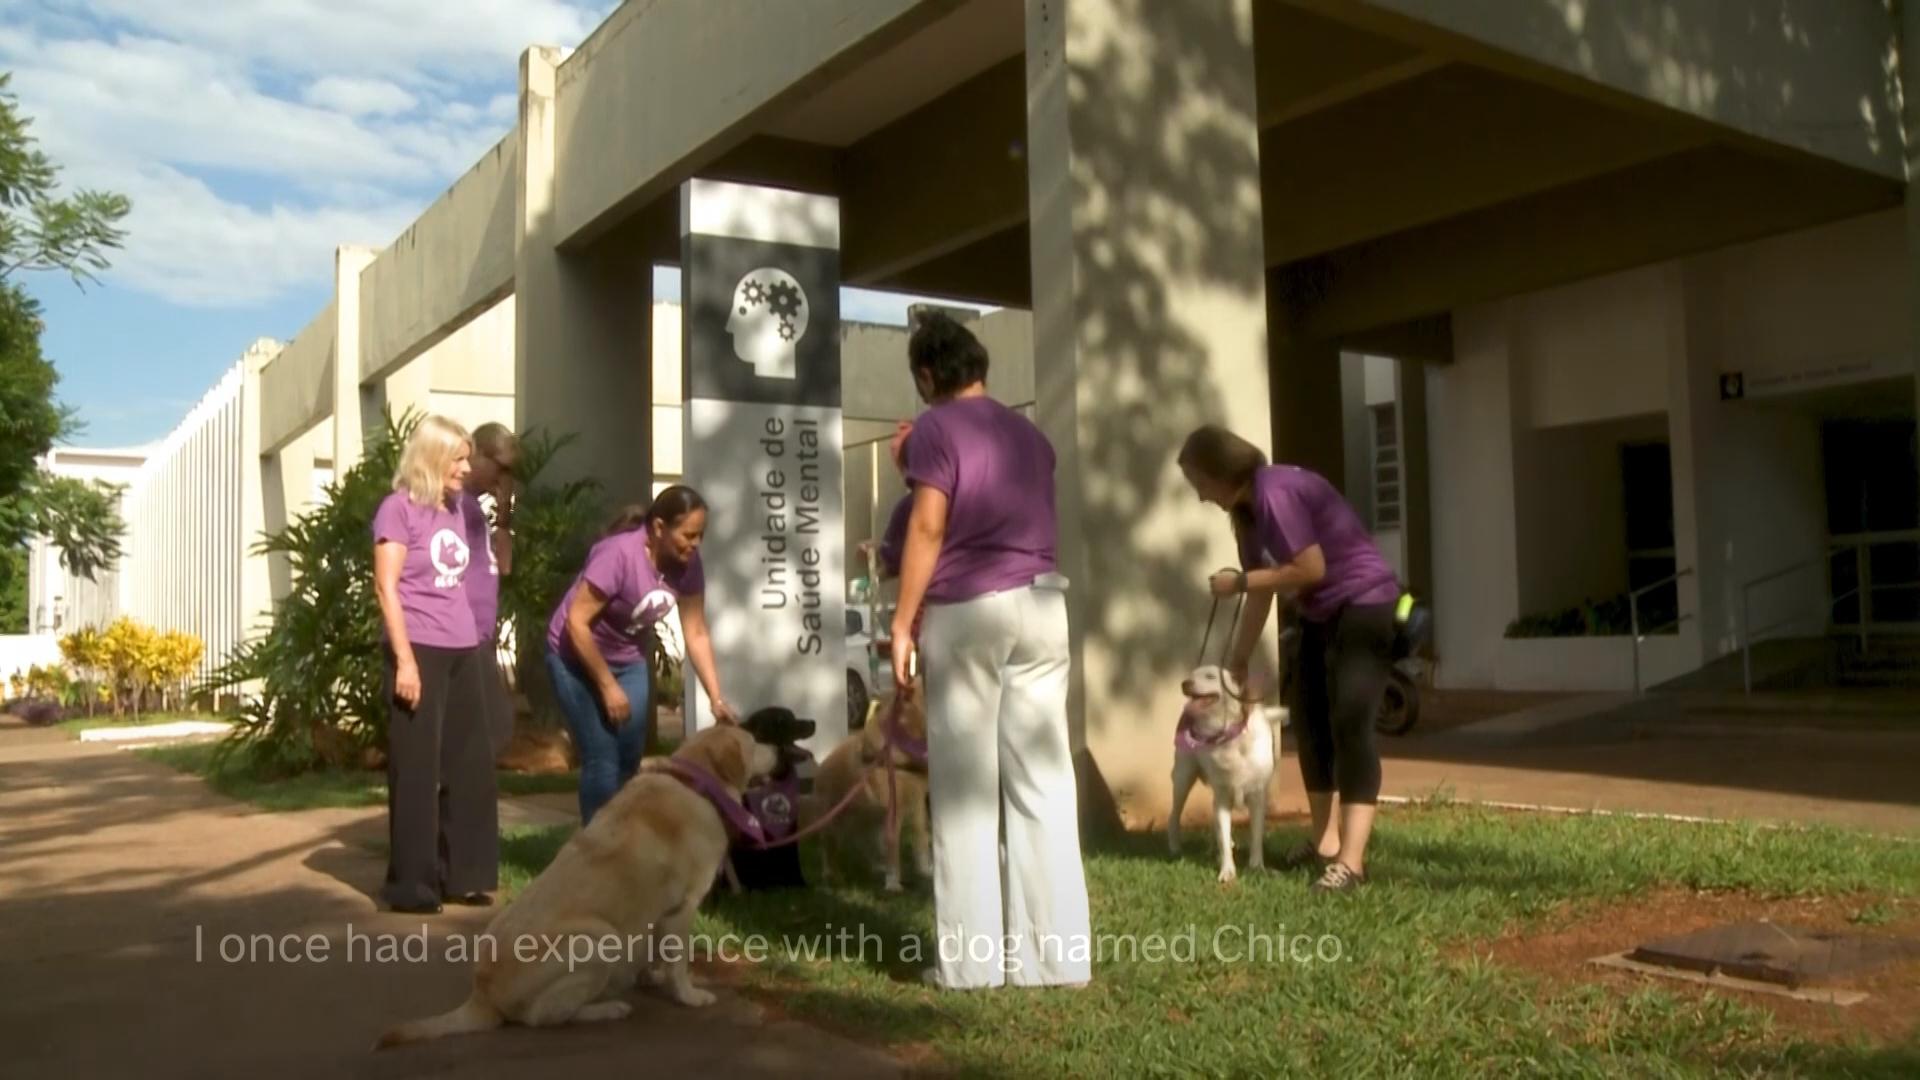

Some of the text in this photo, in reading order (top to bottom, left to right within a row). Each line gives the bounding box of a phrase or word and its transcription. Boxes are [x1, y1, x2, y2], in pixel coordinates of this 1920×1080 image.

[760, 416, 787, 610] Unidade de
[794, 420, 822, 655] Saúde Mental
